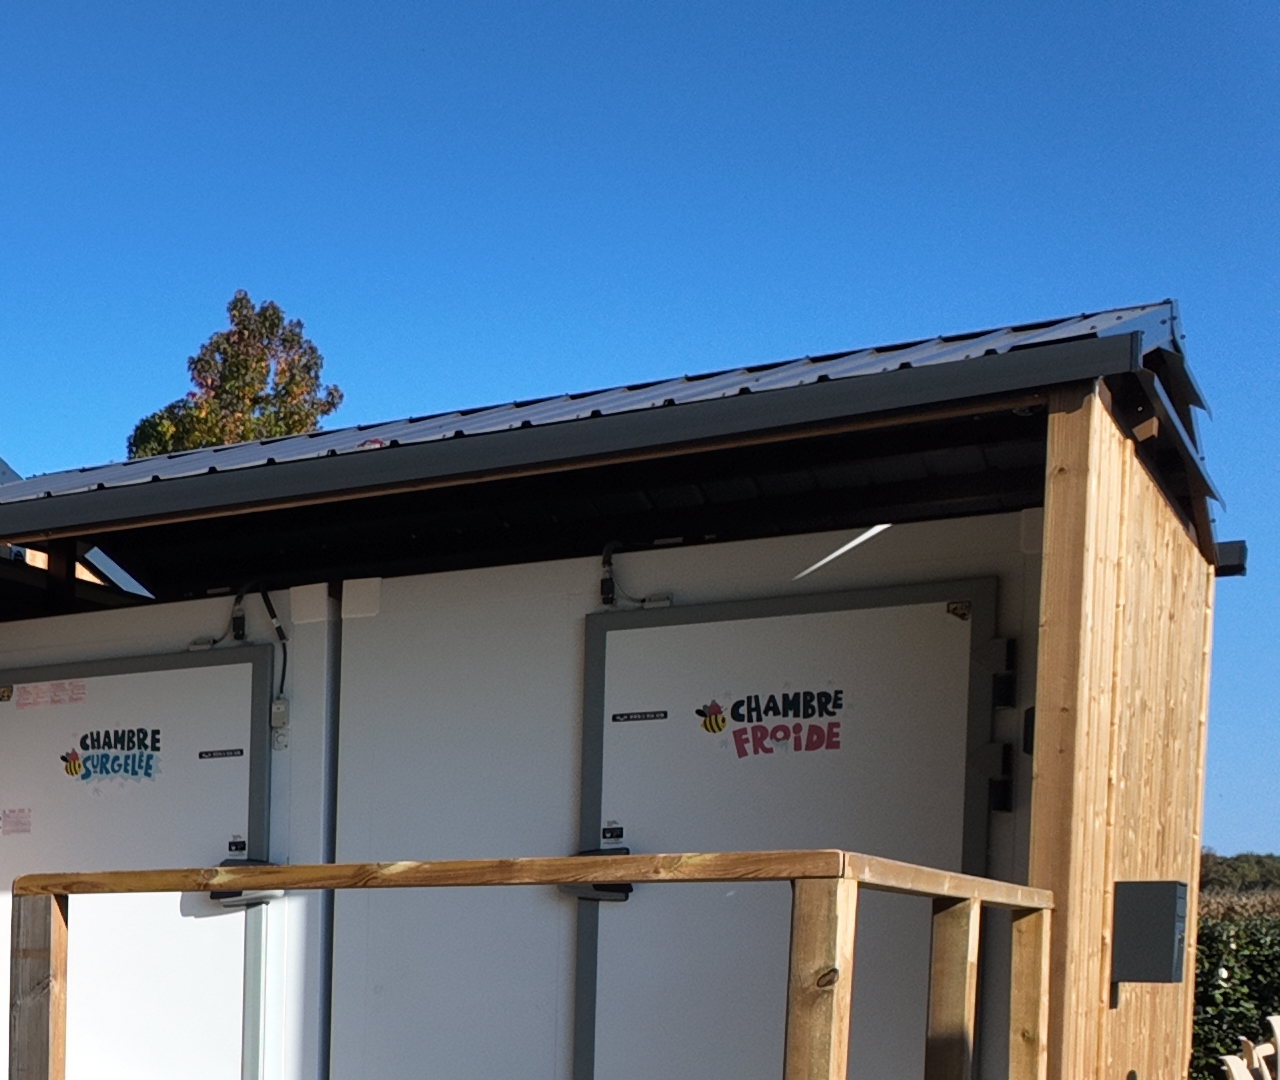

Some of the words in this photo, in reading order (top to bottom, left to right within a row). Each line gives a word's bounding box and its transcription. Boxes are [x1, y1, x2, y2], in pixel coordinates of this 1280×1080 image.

[731, 690, 843, 723] CHAMBRE
[80, 728, 161, 752] CHAMBRE
[81, 751, 154, 781] SURGELÉE
